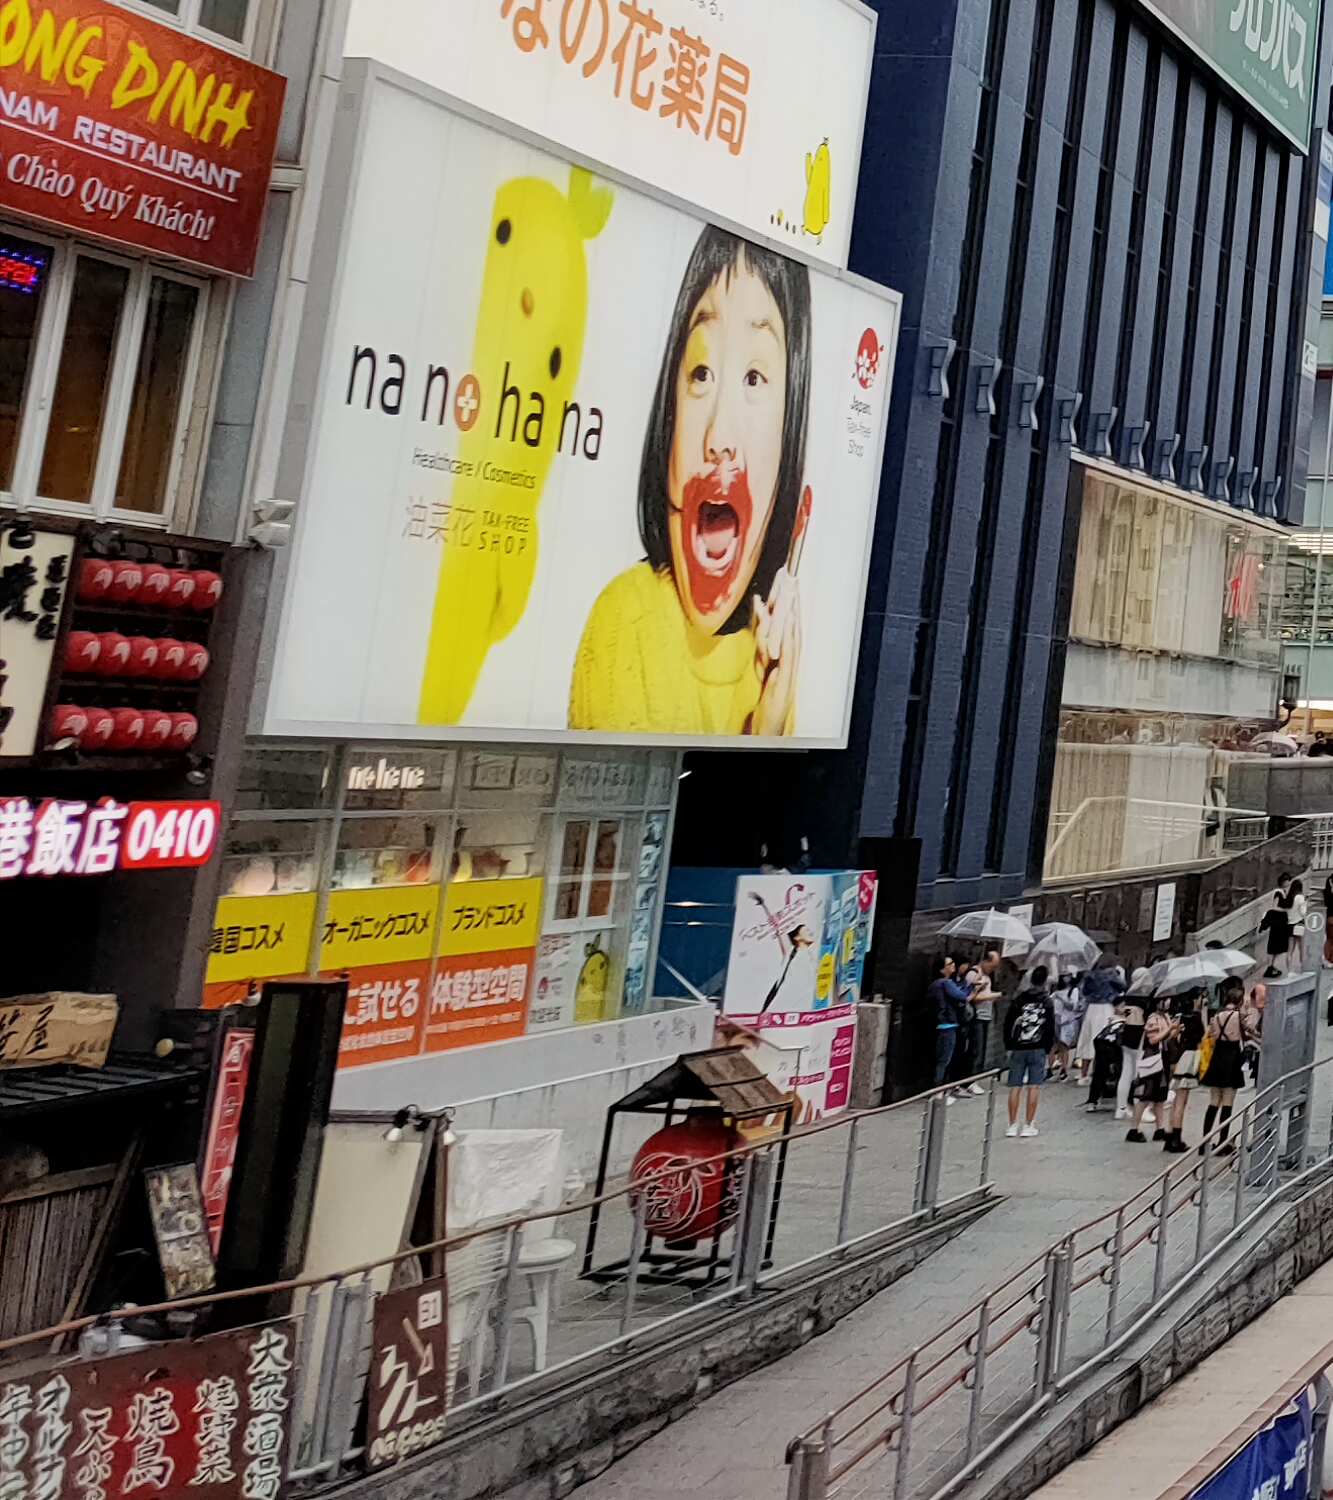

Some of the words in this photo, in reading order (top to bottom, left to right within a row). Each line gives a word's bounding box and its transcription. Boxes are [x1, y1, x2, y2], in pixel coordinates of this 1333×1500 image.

[110, 39, 254, 148] DINH
[73, 116, 243, 193] RESTAURANT
[7, 153, 76, 197] Chào
[80, 176, 134, 220] Quý
[133, 194, 216, 242] Khách!
[126, 806, 214, 861] 0410
[320, 910, 431, 947] オーガニックコスメ
[452, 901, 528, 931] ブランドコスメ
[122, 1387, 180, 1495] 焼鳥
